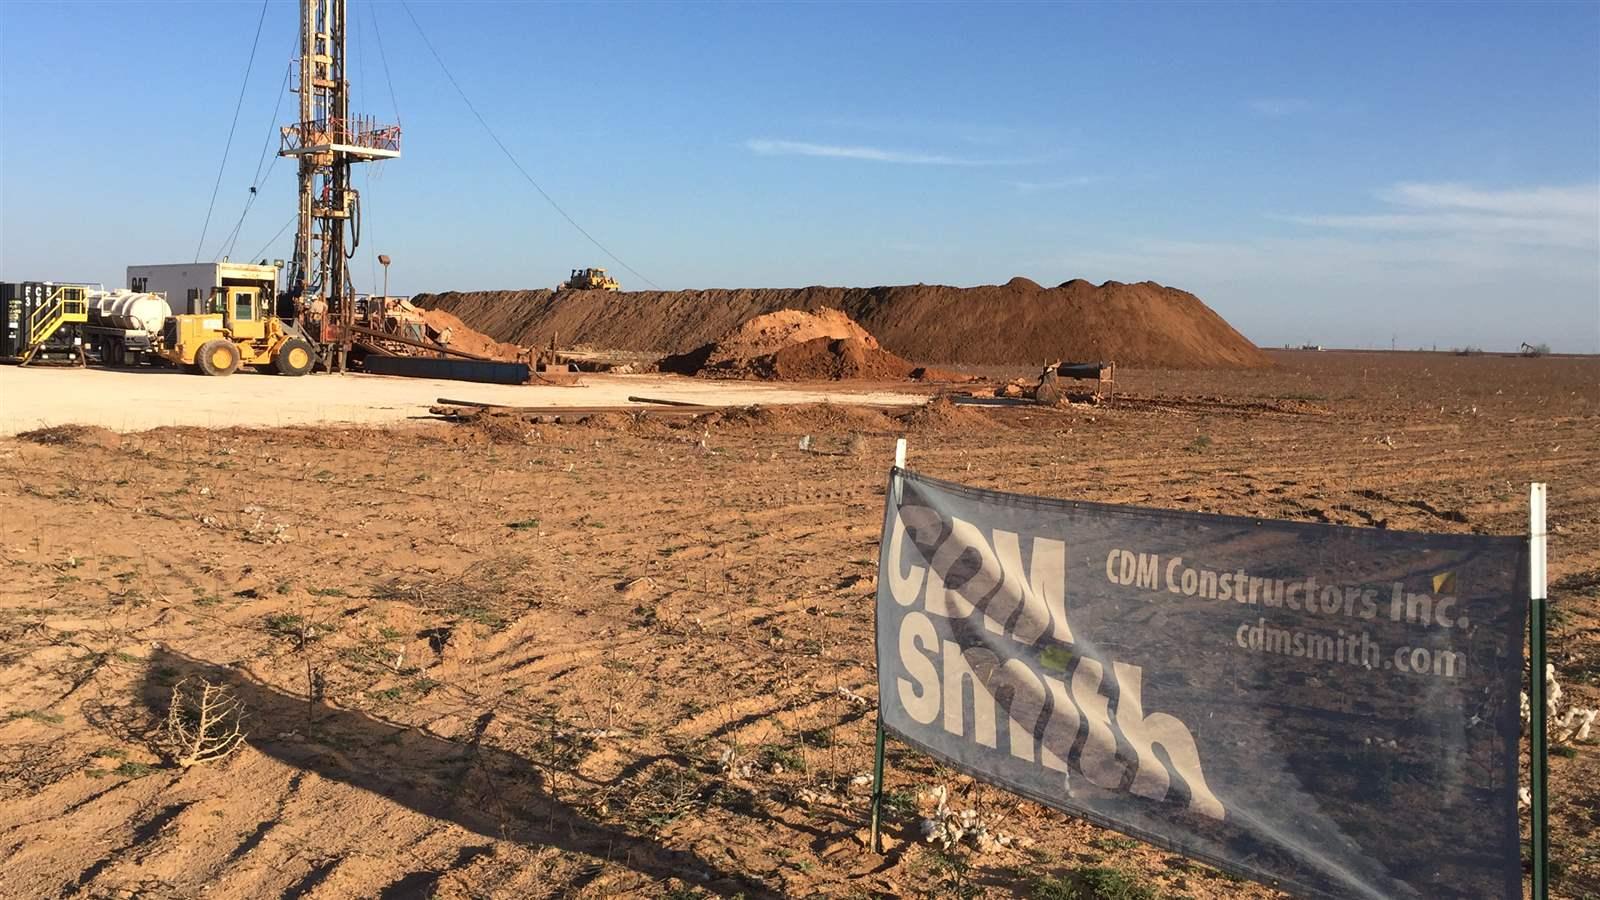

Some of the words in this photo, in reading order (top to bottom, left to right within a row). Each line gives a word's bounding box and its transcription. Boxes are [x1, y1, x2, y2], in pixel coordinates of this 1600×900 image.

[888, 504, 1075, 646] CDM
[1106, 548, 1158, 591] CDM
[1166, 557, 1378, 621] Constructors
[1390, 582, 1469, 629] Inc.
[1236, 618, 1467, 678] cdmsmith.com
[897, 611, 1226, 821] Smith
